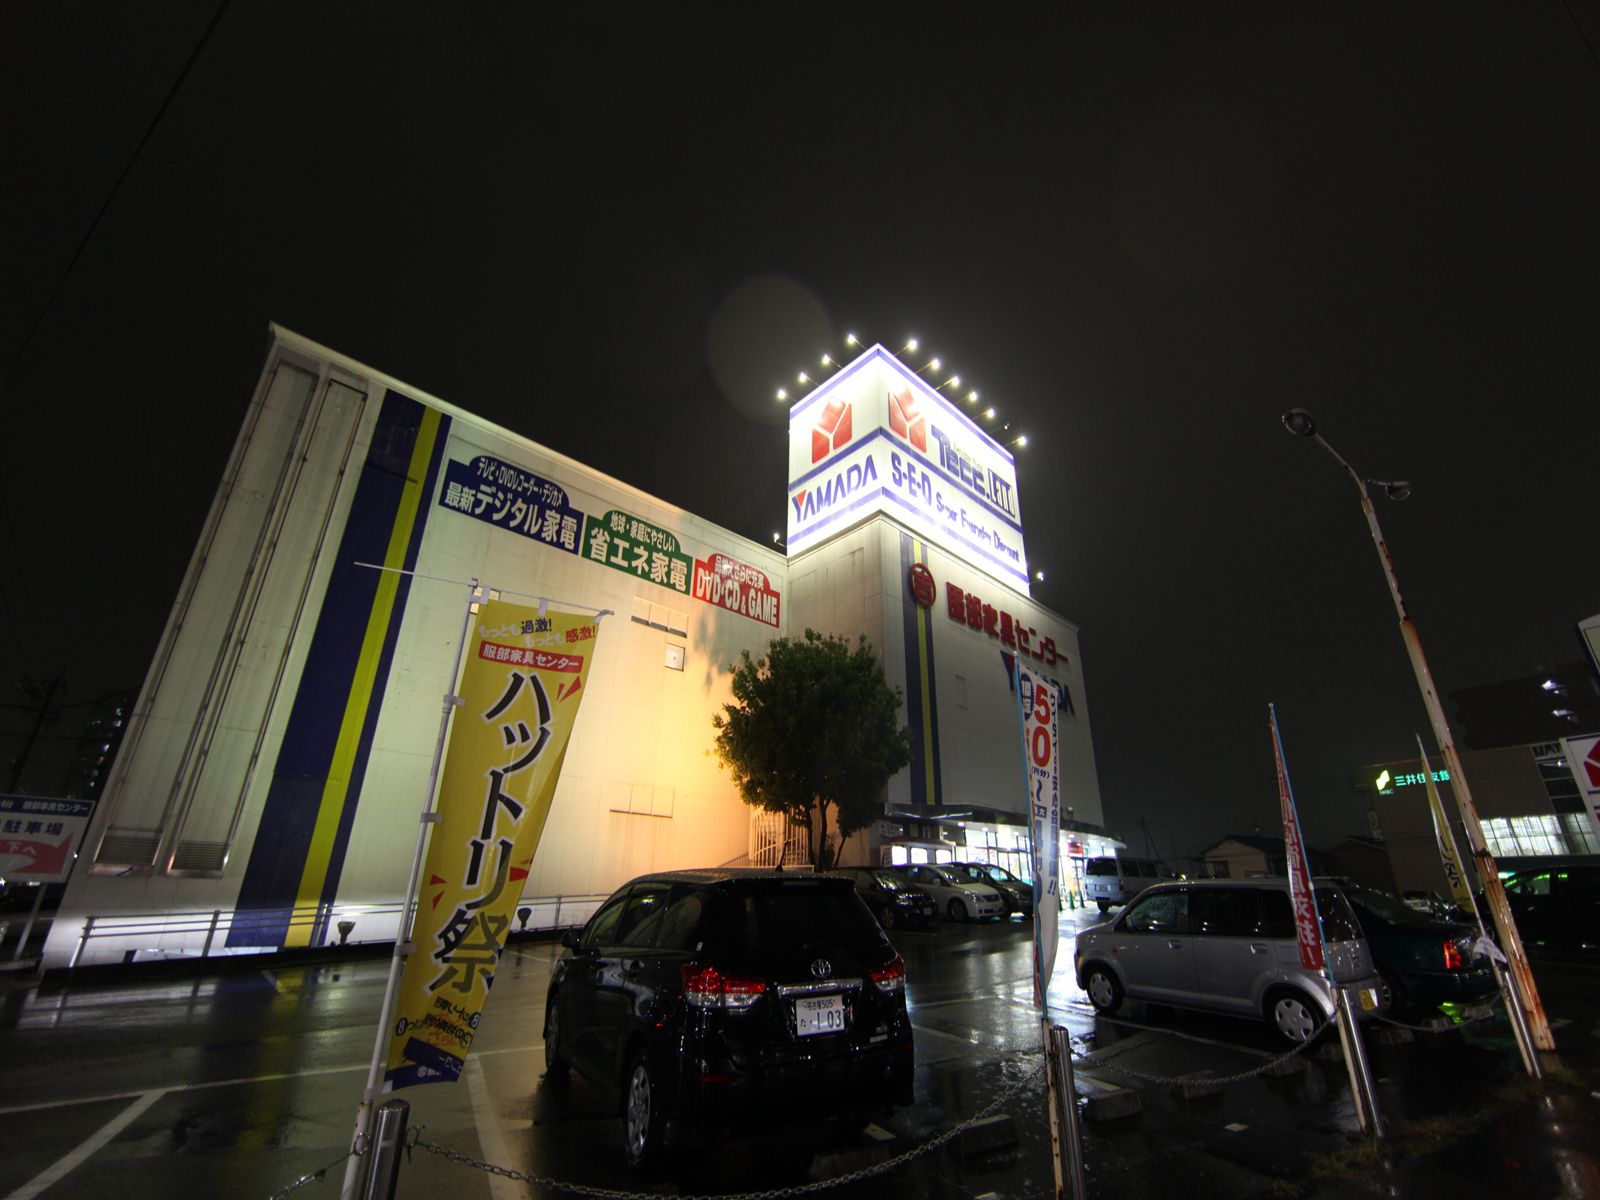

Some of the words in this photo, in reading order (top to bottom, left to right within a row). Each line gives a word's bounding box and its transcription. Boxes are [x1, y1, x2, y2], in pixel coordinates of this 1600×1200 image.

[445, 481, 578, 550] 最新デジタル家電
[792, 455, 878, 523] YAMADA
[589, 527, 688, 593] 省エネ家電
[610, 511, 676, 553] 地球・家庭にやさしい
[482, 645, 580, 670] 服部家具センター
[425, 671, 552, 995] ハットリ祭
